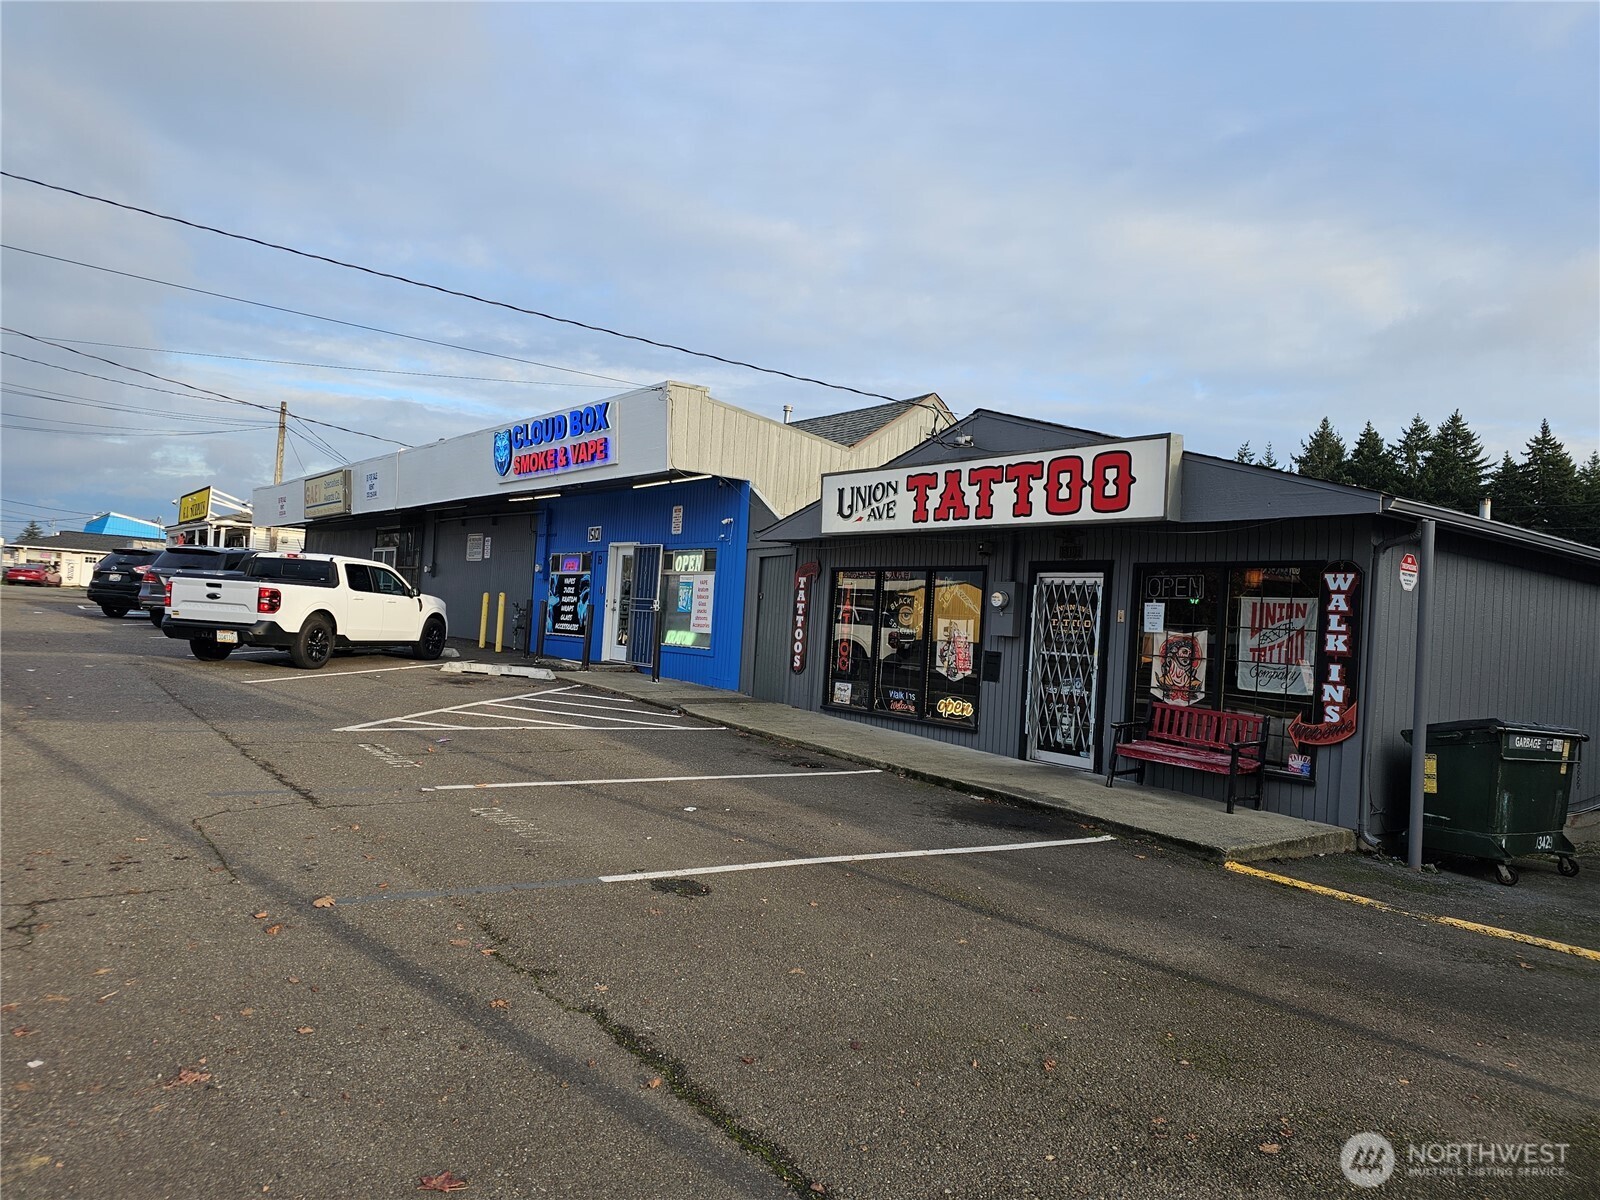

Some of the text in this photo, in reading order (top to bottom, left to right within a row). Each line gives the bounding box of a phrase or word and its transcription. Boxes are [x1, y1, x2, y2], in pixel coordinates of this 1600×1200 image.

[512, 402, 610, 449] CLOUD BOX
[513, 437, 608, 475] SMOKE & VAPE
[837, 480, 899, 519] UNION
[906, 450, 1137, 524] TATTOO
[867, 500, 896, 522] AVE
[675, 555, 702, 572] OPEN
[1148, 577, 1202, 597] OPEN
[890, 597, 911, 610] BLACK
[793, 577, 807, 667] TATTOOS
[1250, 602, 1307, 640] UNION
[1250, 625, 1305, 665] TATTOO
[1323, 574, 1354, 722] WALK INS
[1250, 665, 1301, 689] Company
[889, 690, 904, 700] Walk
[937, 698, 974, 718] open
[1515, 737, 1541, 749] GARBAGE
